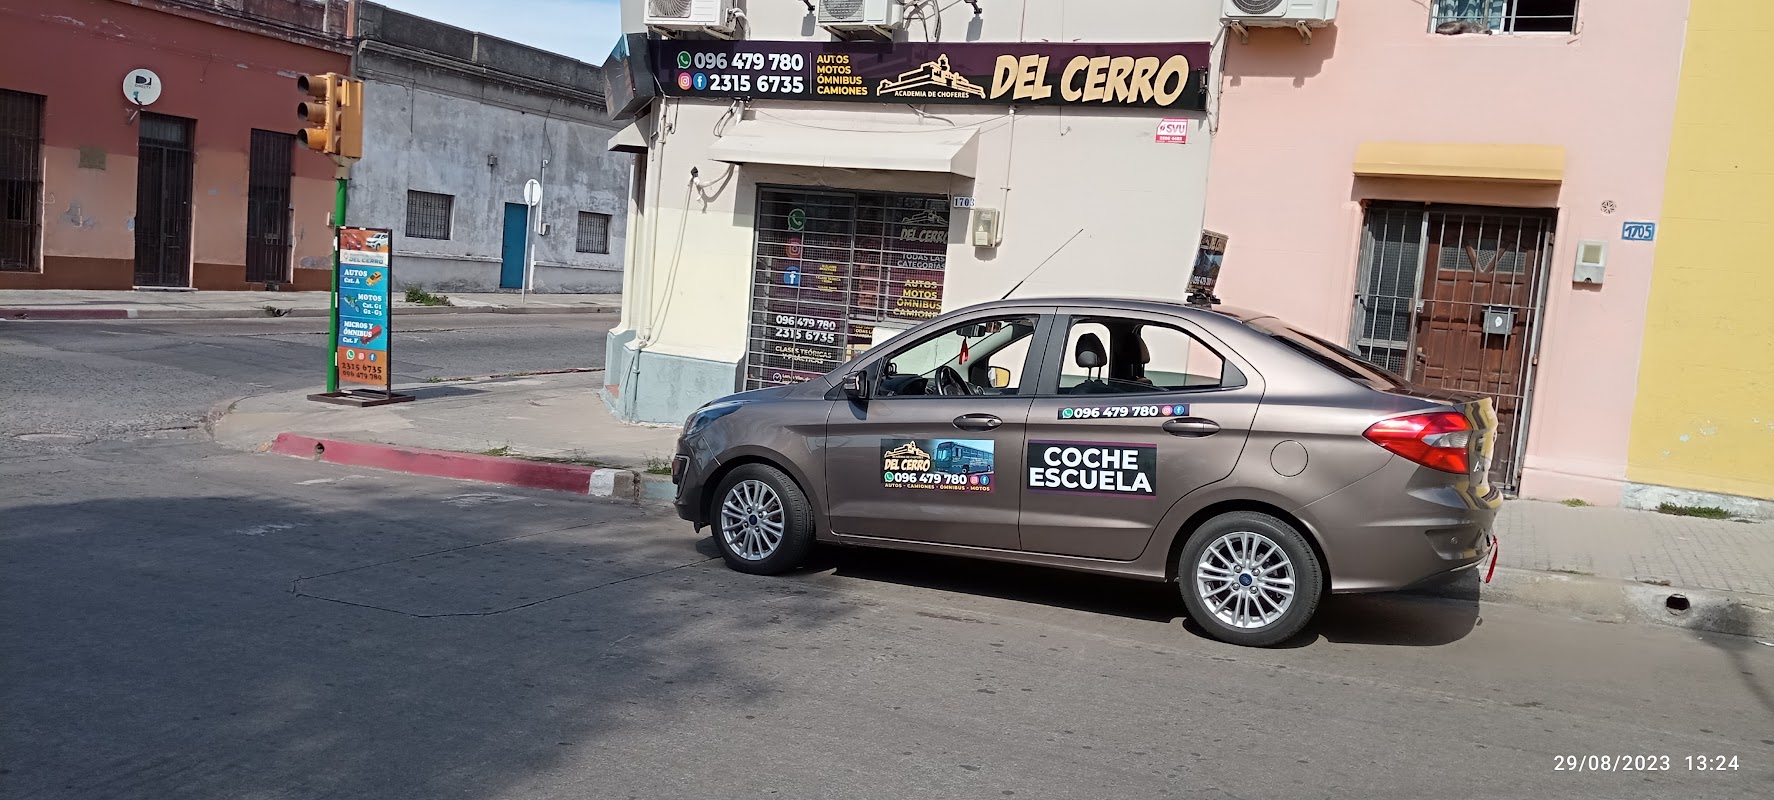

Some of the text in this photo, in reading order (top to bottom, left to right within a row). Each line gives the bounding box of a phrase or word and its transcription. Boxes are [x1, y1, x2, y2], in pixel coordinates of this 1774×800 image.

[694, 52, 804, 71] 096 479 780
[816, 54, 850, 64] AUTOS
[816, 65, 852, 75] MOTOS
[710, 74, 804, 94] 2315 6735
[816, 74, 862, 85] ÓMNIBUS
[990, 54, 1190, 106] DEL CERRO
[816, 85, 868, 96] CAMIONES
[1166, 124, 1185, 133] SVU
[954, 198, 975, 206] 1703
[900, 229, 916, 241] DEL
[1624, 225, 1652, 239] 1705
[904, 280, 937, 289] AUTOS
[903, 289, 937, 299] MOTOS
[776, 315, 836, 330] 096 479 780
[343, 328, 372, 338] ÓMNIBUS
[776, 328, 834, 343] 2315 6735
[800, 349, 831, 358] TEÓRICAS
[342, 363, 382, 374] 2315 6735
[1074, 406, 1158, 418] 096 479 780
[1044, 446, 1139, 470] COCHE
[884, 459, 930, 472] DEL CERRO
[894, 473, 967, 485] 096 479 780
[1029, 467, 1152, 492] ESCUELA
